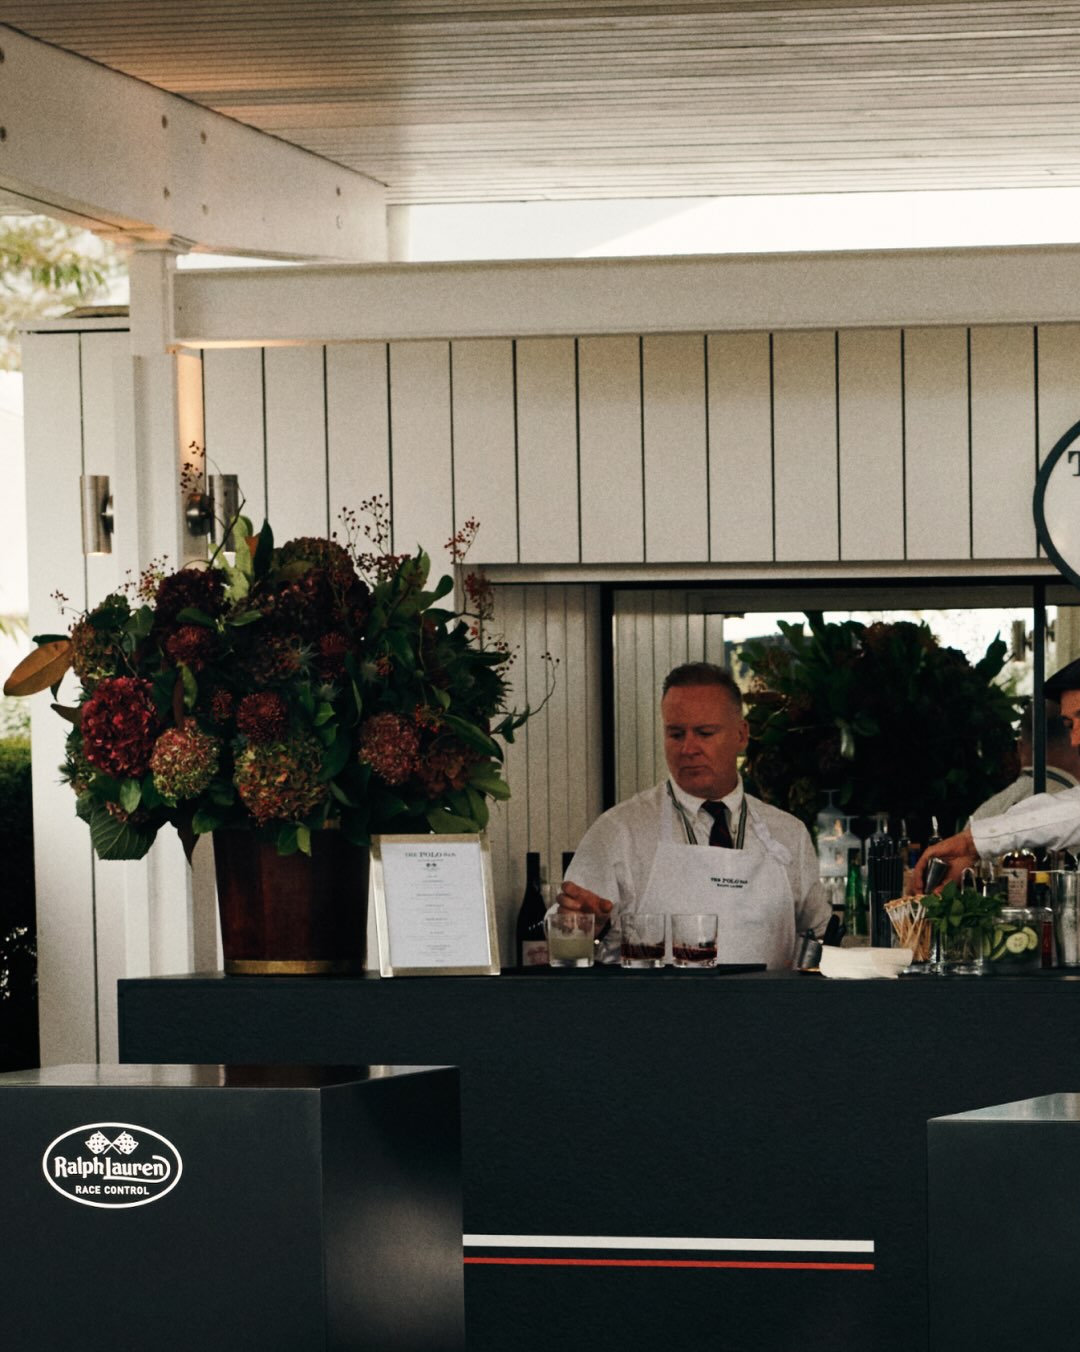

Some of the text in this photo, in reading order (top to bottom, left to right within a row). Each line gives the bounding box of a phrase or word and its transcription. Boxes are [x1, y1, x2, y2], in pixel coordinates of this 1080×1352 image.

[54, 1154, 171, 1183] Ralph Lauren
[75, 1185, 150, 1195] RACE CONTROL
